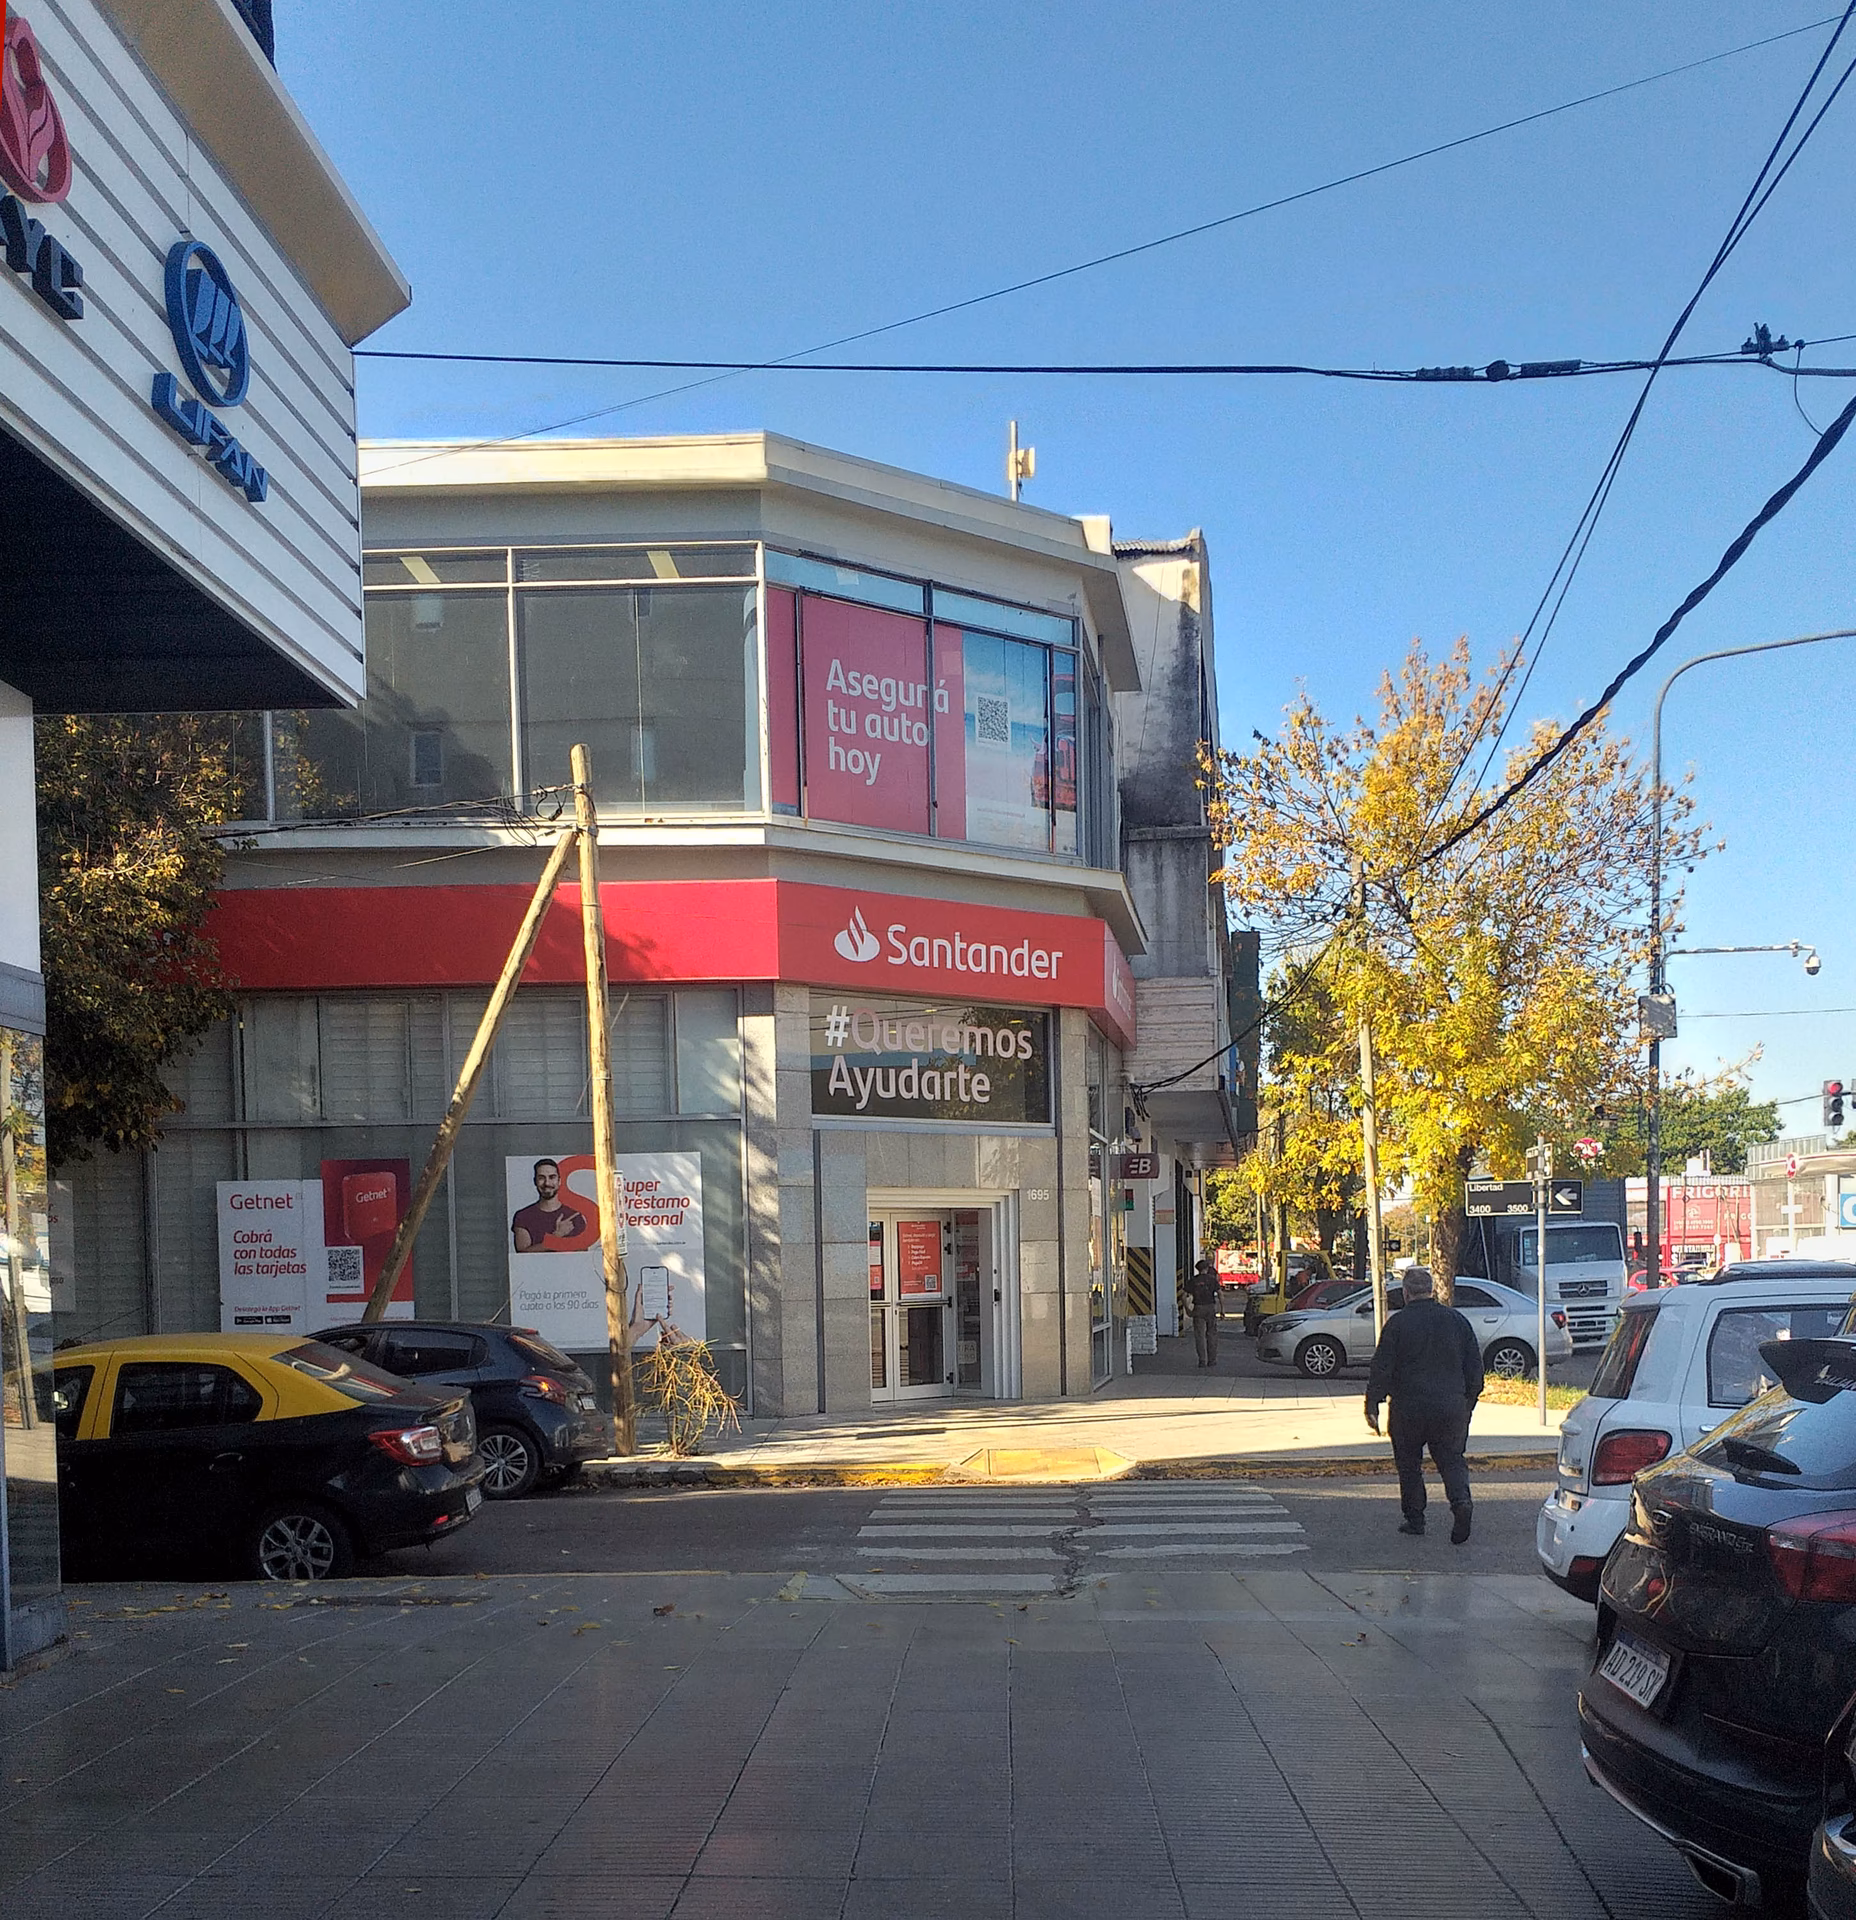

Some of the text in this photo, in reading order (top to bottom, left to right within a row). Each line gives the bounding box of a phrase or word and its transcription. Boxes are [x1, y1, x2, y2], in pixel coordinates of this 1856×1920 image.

[151, 372, 268, 502] LIFAN
[826, 658, 950, 714] Asegurá
[828, 699, 930, 747] tu auto
[829, 736, 881, 786] hoy
[887, 923, 1064, 980] Santander
[825, 1004, 1034, 1060] #Queremos
[828, 1055, 991, 1110] Ayudarte
[356, 1188, 388, 1203] Getnet
[1027, 1189, 1050, 1201] 1695
[1469, 1183, 1504, 1192] Libertad
[230, 1193, 294, 1210] Getnet
[1469, 1204, 1529, 1213] 3400 3500
[233, 1229, 272, 1244] Cobrá
[234, 1245, 297, 1259] con todas
[234, 1261, 307, 1279] las tarjetas
[553, 1290, 587, 1301] primera
[520, 1302, 544, 1311] cuota
[554, 1301, 566, 1310] los
[567, 1300, 580, 1310] 90
[1604, 1646, 1628, 1676] AD
